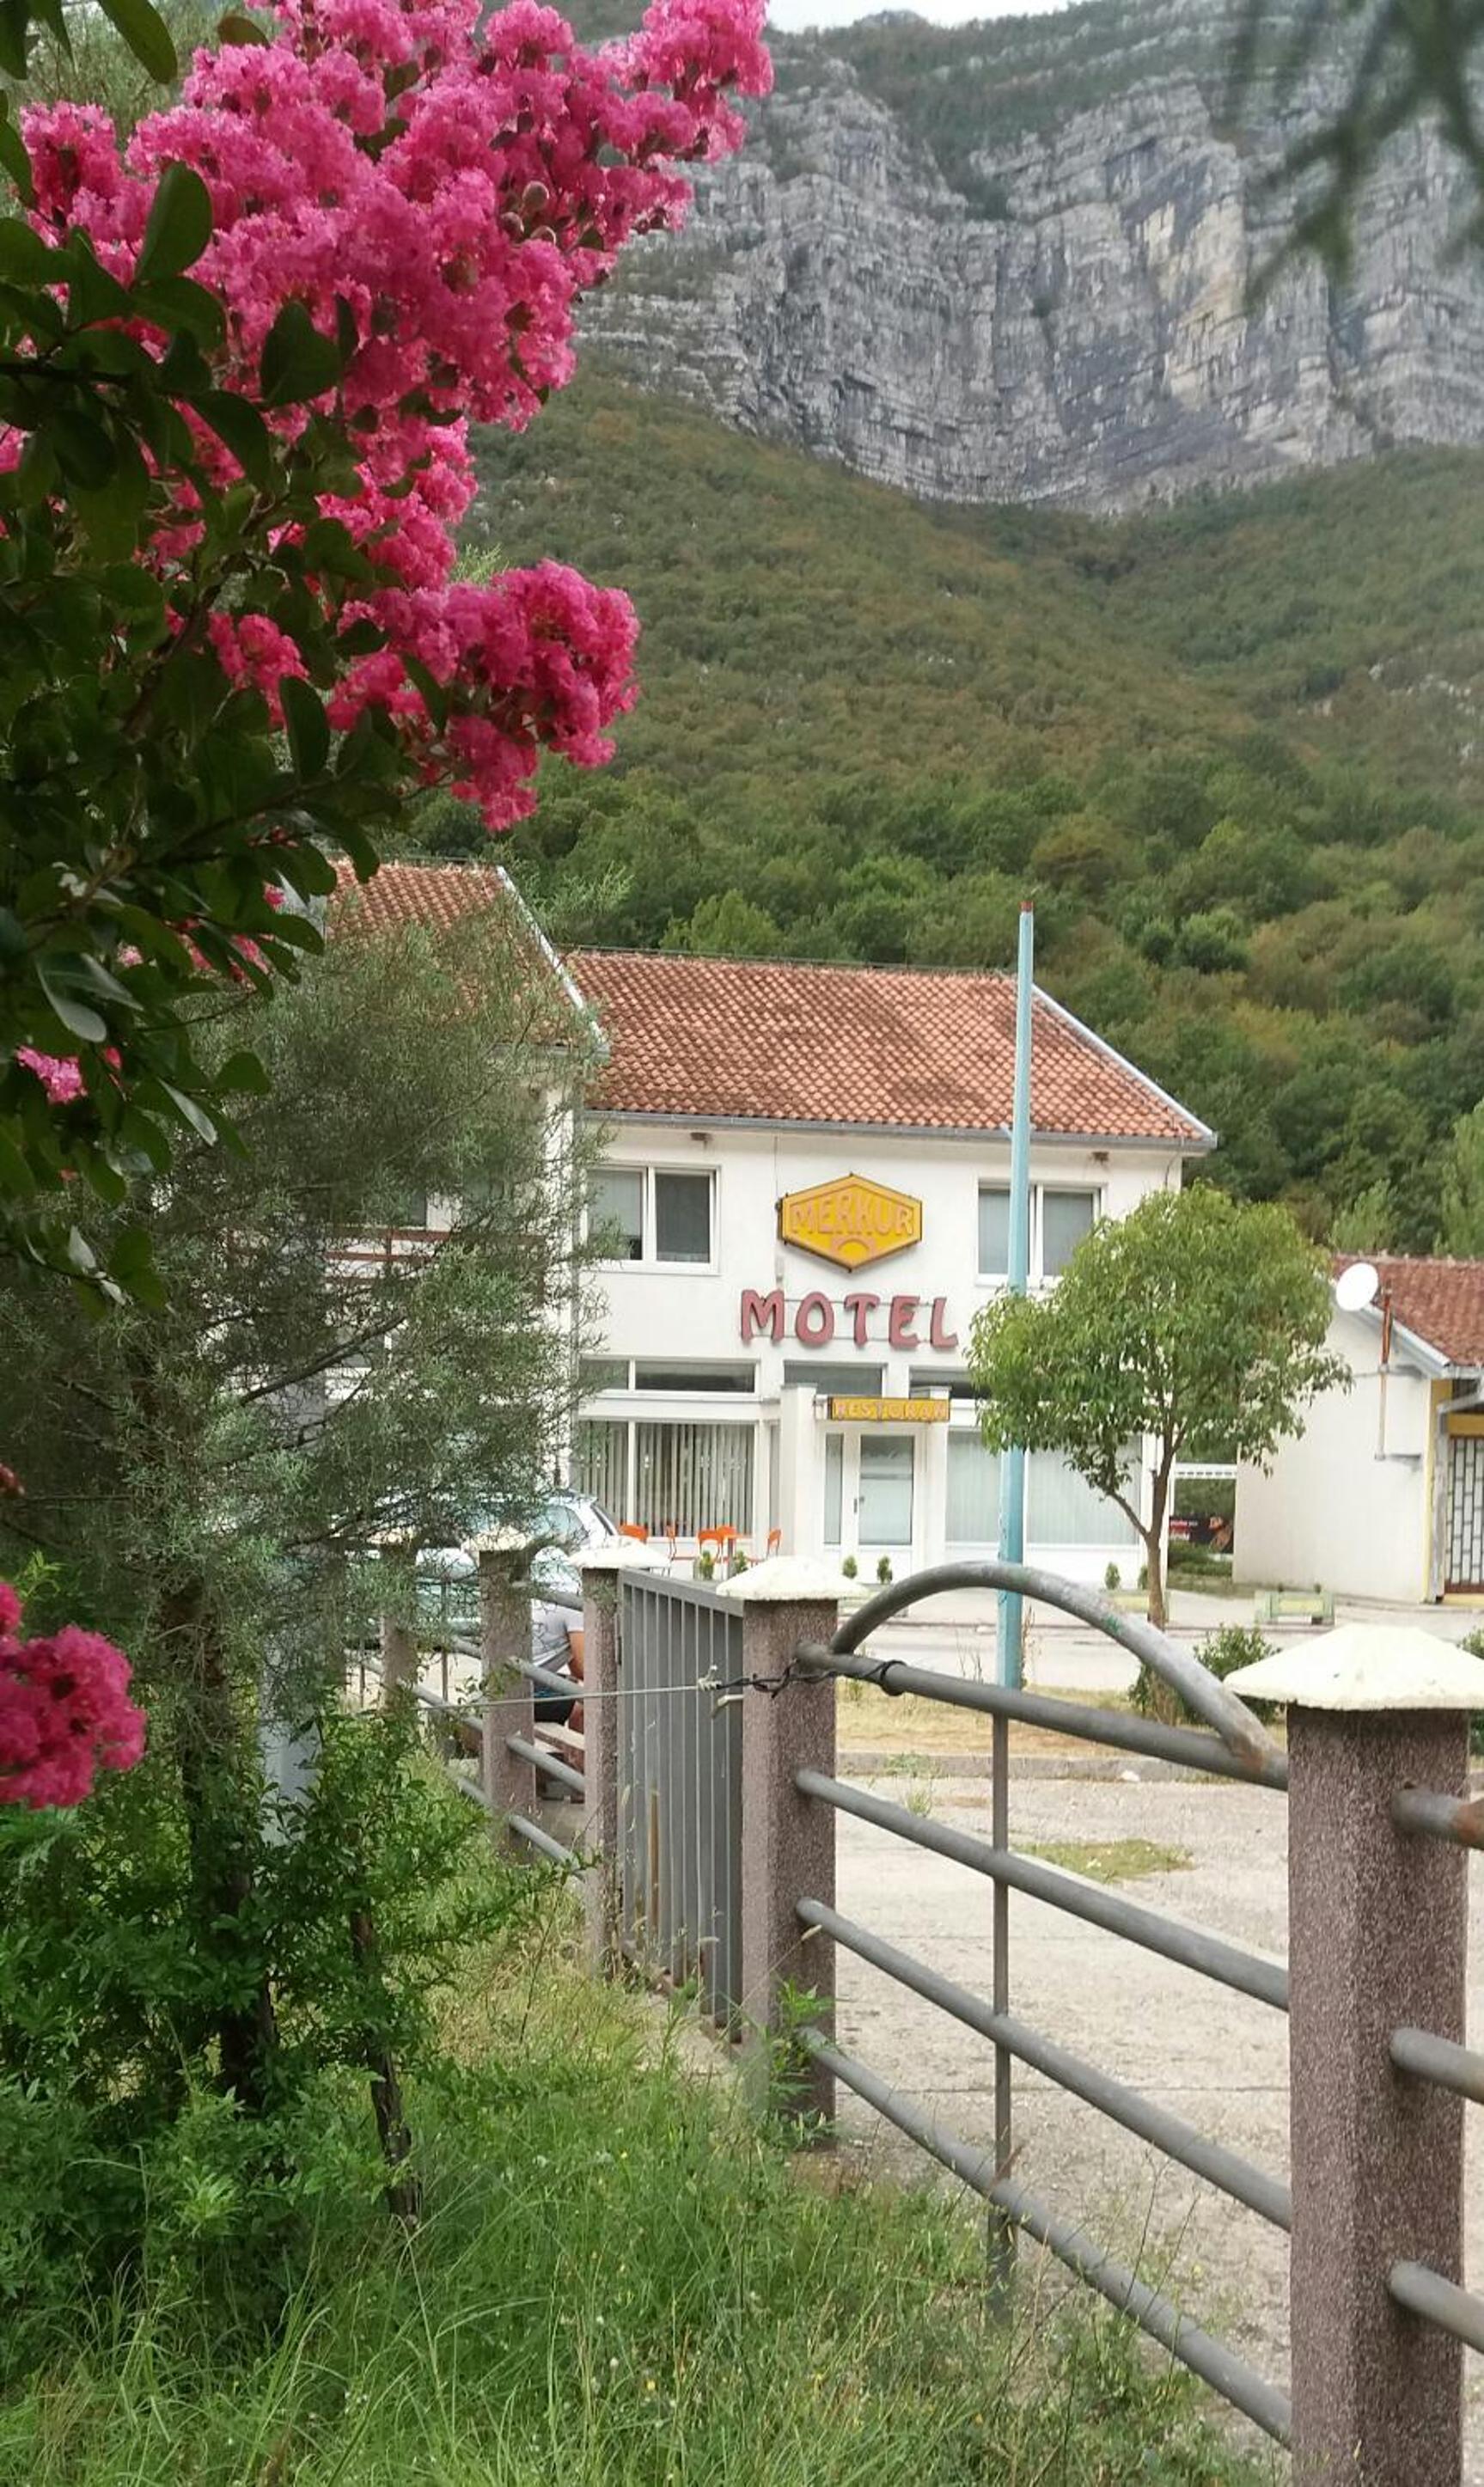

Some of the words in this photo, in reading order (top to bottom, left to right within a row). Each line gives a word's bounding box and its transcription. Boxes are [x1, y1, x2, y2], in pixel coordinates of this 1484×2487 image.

[791, 1193, 913, 1235] MERKUR
[740, 1289, 959, 1347] MOTEL
[834, 1401, 946, 1420] RESTORAN
